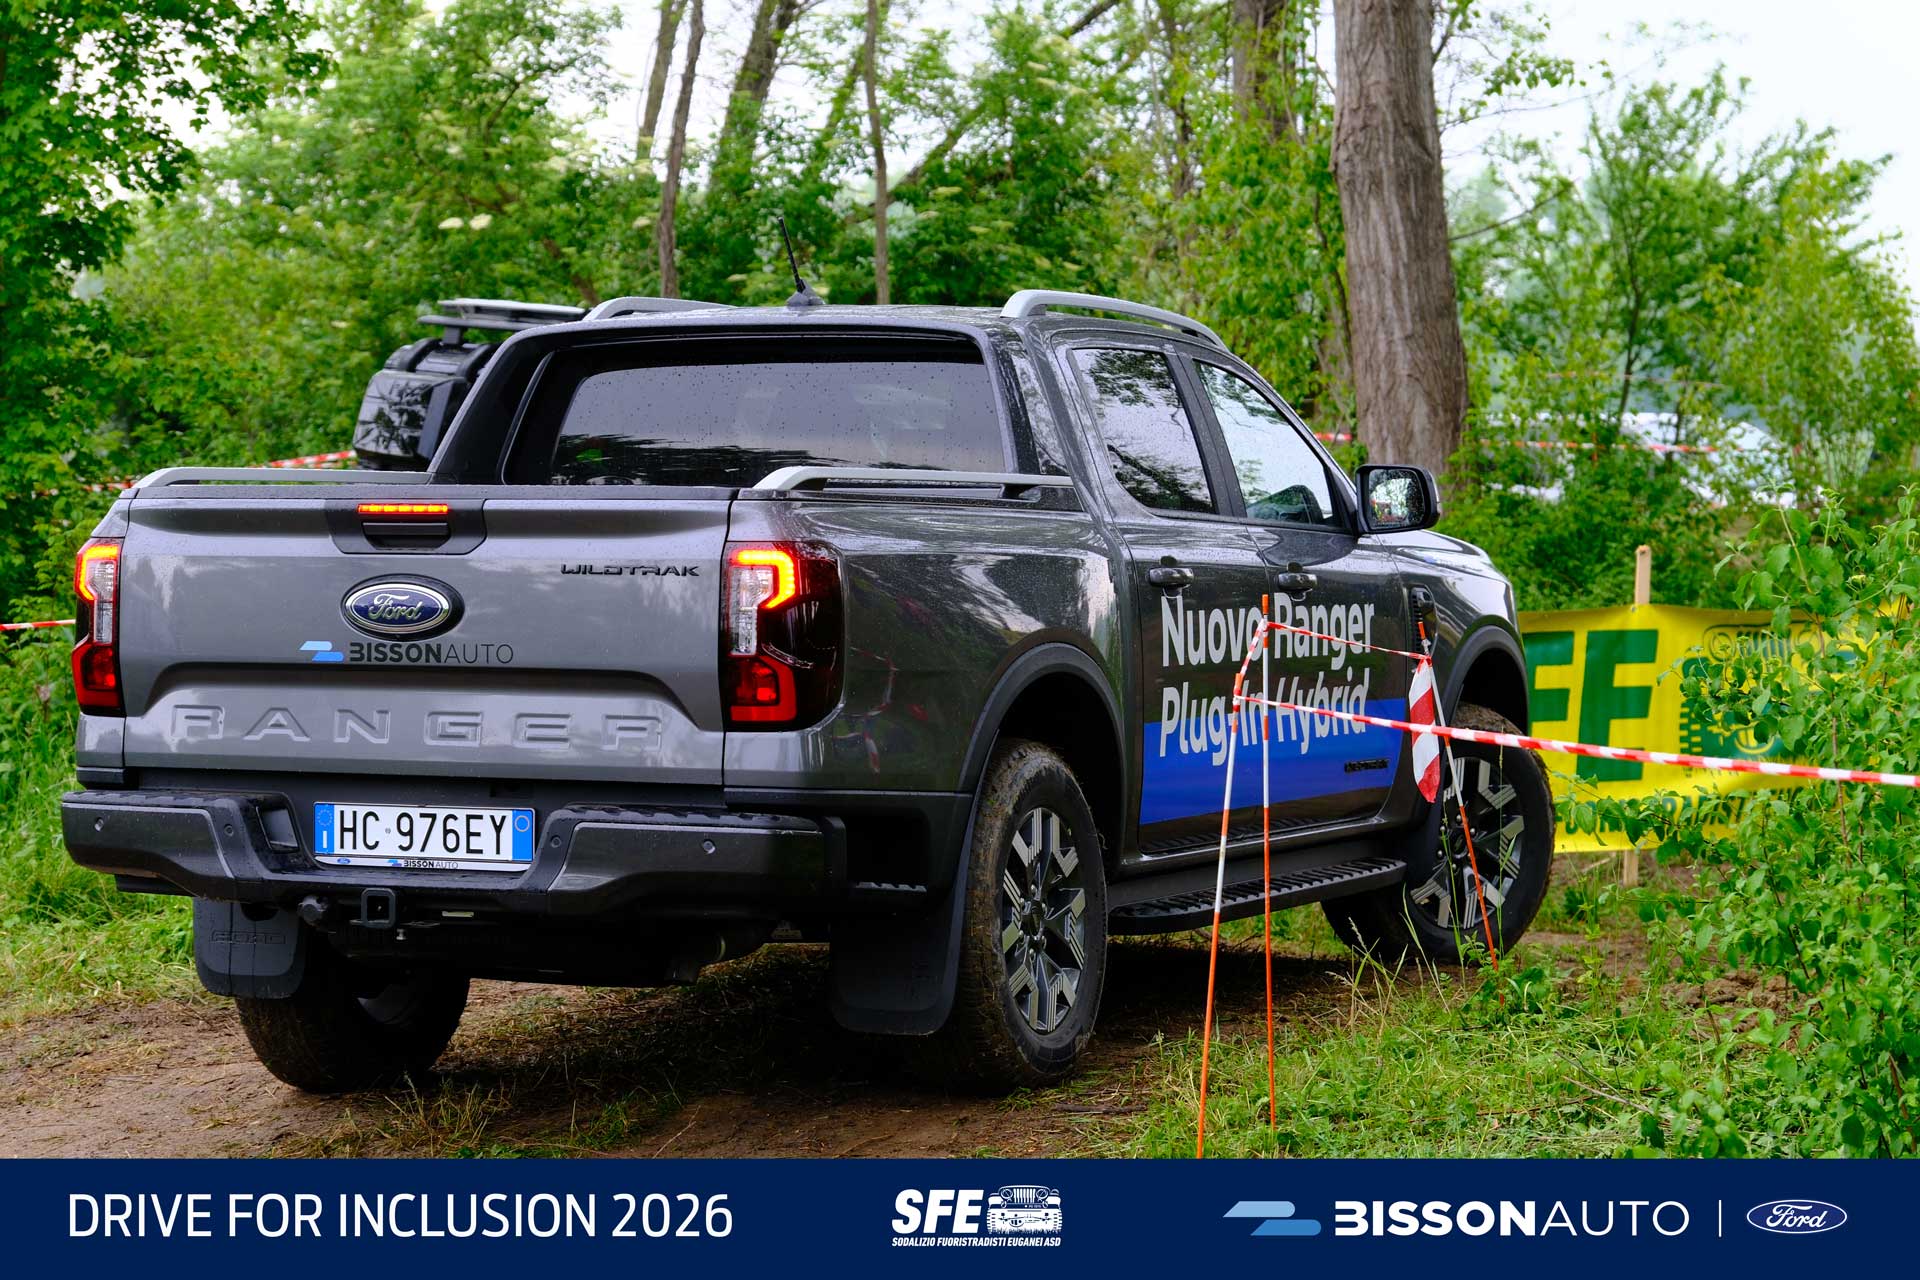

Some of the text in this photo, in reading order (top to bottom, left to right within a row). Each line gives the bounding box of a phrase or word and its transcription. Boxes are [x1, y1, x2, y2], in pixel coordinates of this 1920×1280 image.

[561, 564, 700, 577] WILDTRAK
[368, 592, 422, 622] Ford
[1161, 592, 1375, 671] Nuovo Ranger
[349, 642, 514, 665] BISSONAUTO
[170, 704, 662, 751] RANGER
[1159, 668, 1370, 767] Plug-In Hybrid
[339, 809, 380, 850] HC
[396, 812, 507, 855] 976EY
[403, 859, 458, 870] BISSONAUTO
